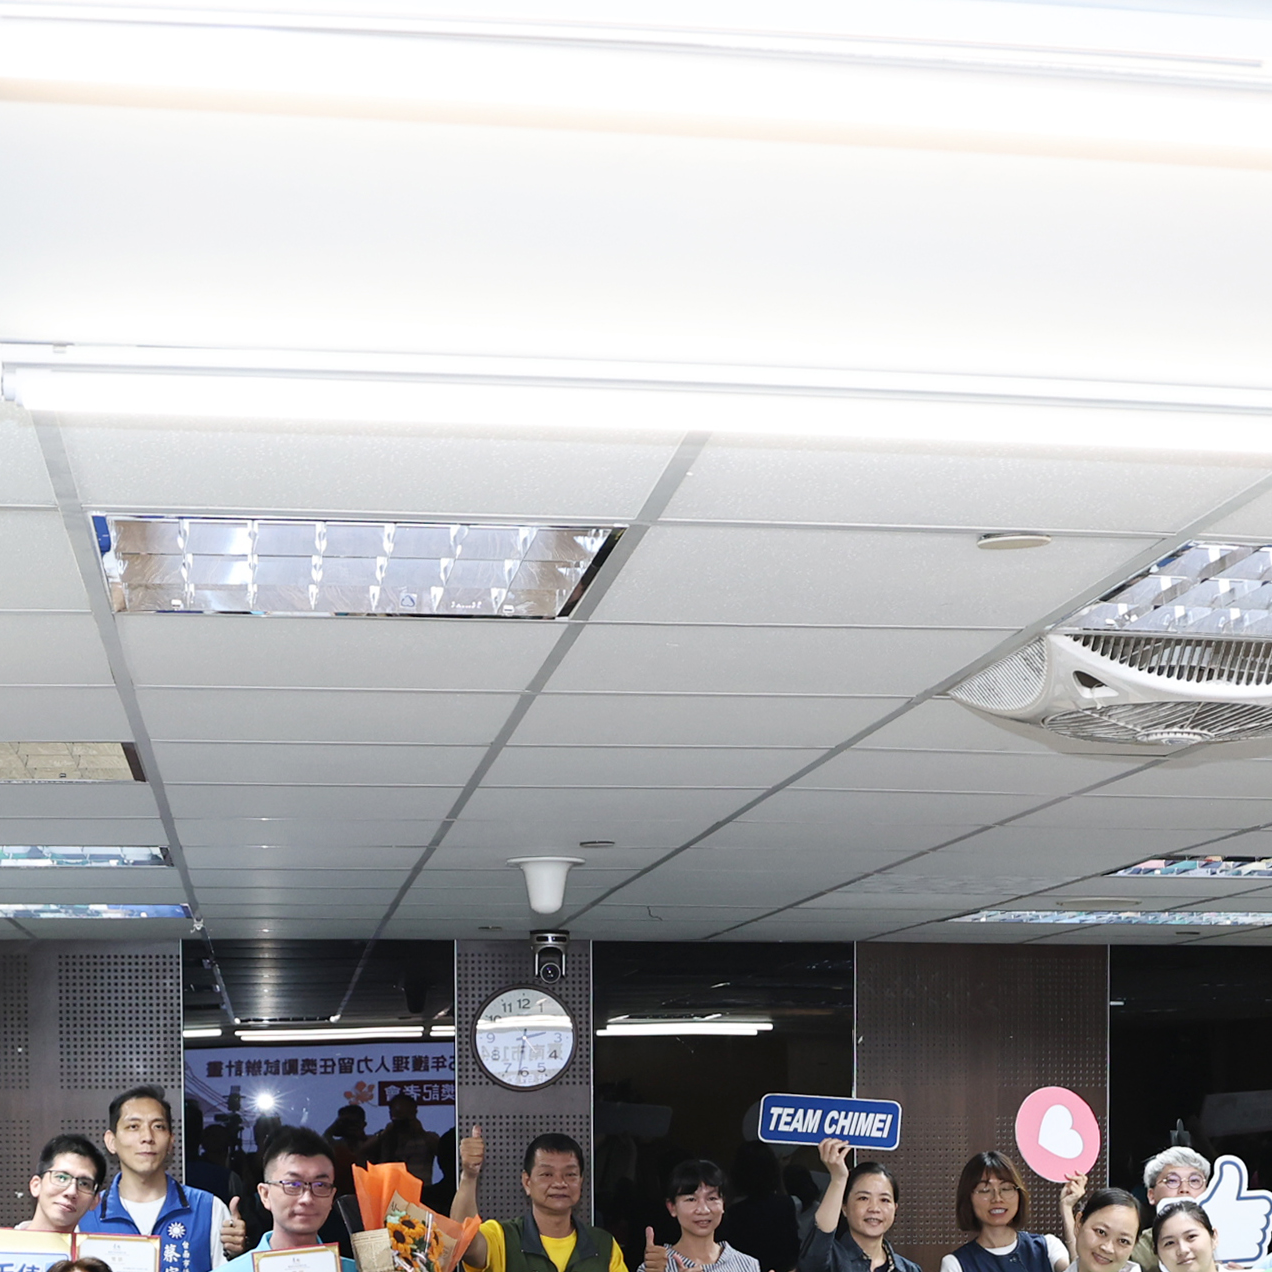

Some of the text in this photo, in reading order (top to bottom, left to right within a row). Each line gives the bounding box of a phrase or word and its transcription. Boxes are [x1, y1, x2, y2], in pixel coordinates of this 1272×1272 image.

[502, 1002, 513, 1013] 11
[517, 998, 531, 1010] 12
[538, 1003, 544, 1013] 1
[486, 1032, 496, 1044] 9
[553, 1032, 563, 1043] 3
[549, 1049, 558, 1060] 4
[503, 1062, 512, 1074] 7
[519, 1066, 530, 1078] 6
[537, 1062, 546, 1074] 5
[768, 1106, 894, 1140] TEAM CHIMEI
